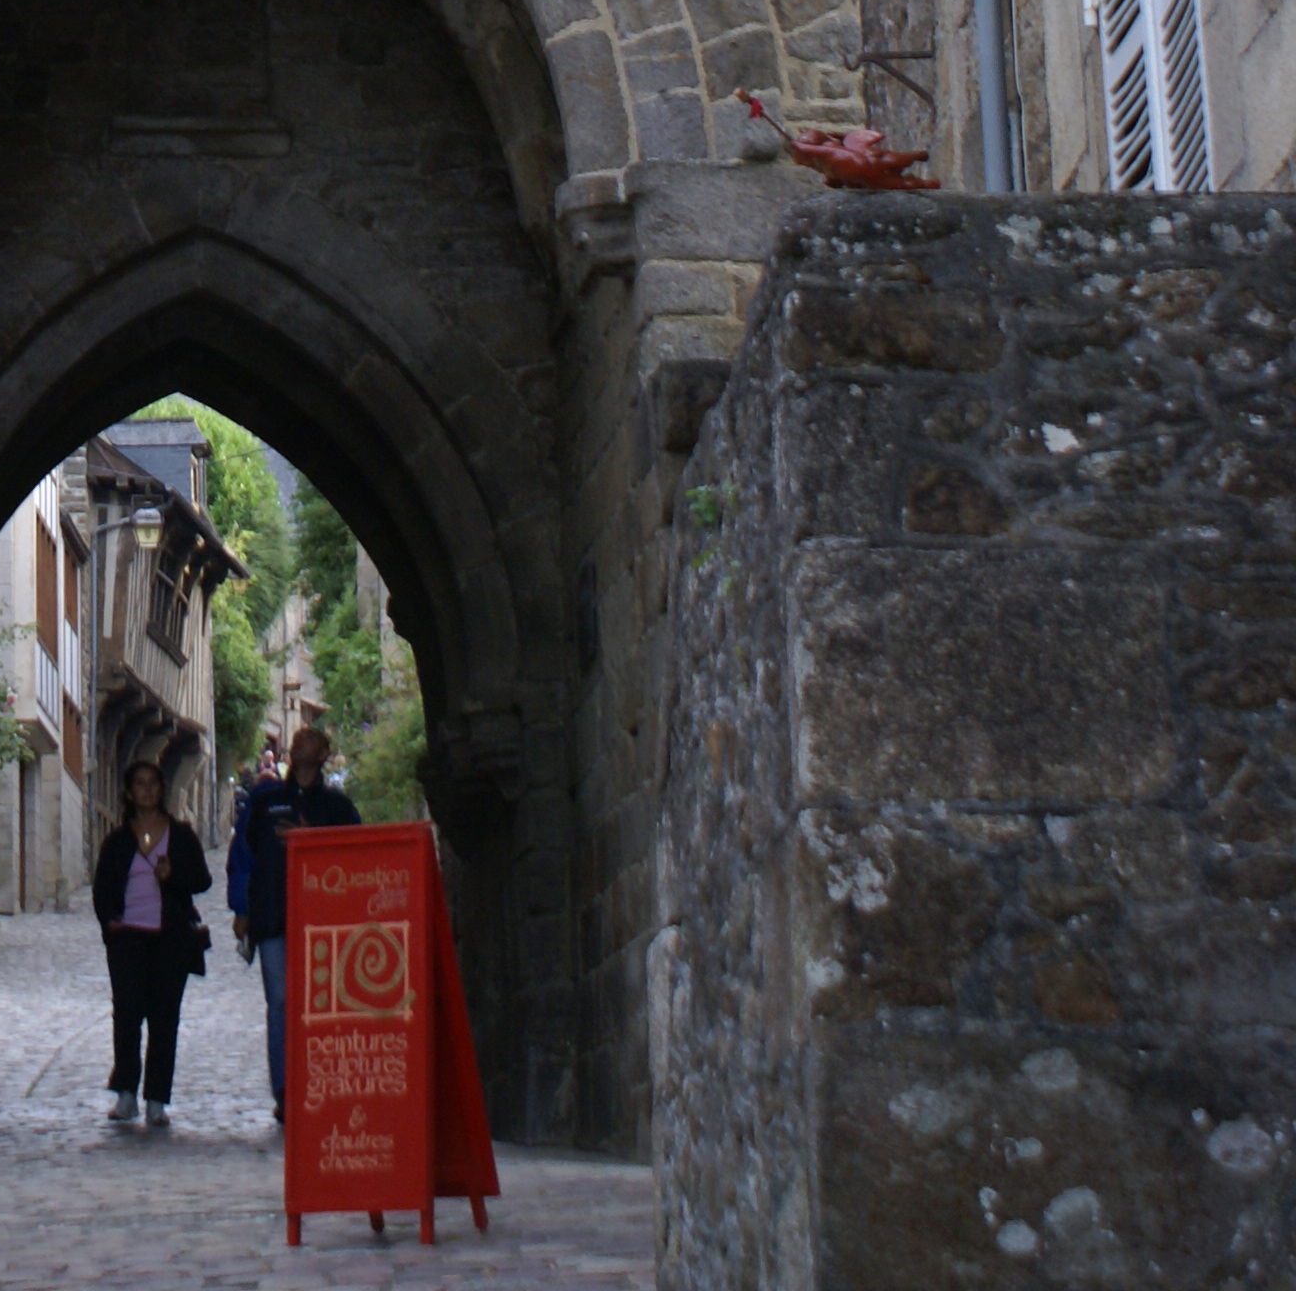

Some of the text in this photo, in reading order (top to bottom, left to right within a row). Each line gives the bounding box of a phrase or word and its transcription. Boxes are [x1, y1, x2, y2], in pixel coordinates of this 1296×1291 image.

[302, 862, 409, 891] la Question
[306, 1026, 408, 1056] peintures
[306, 1049, 407, 1075] sculptures
[304, 1073, 408, 1109] gravures
